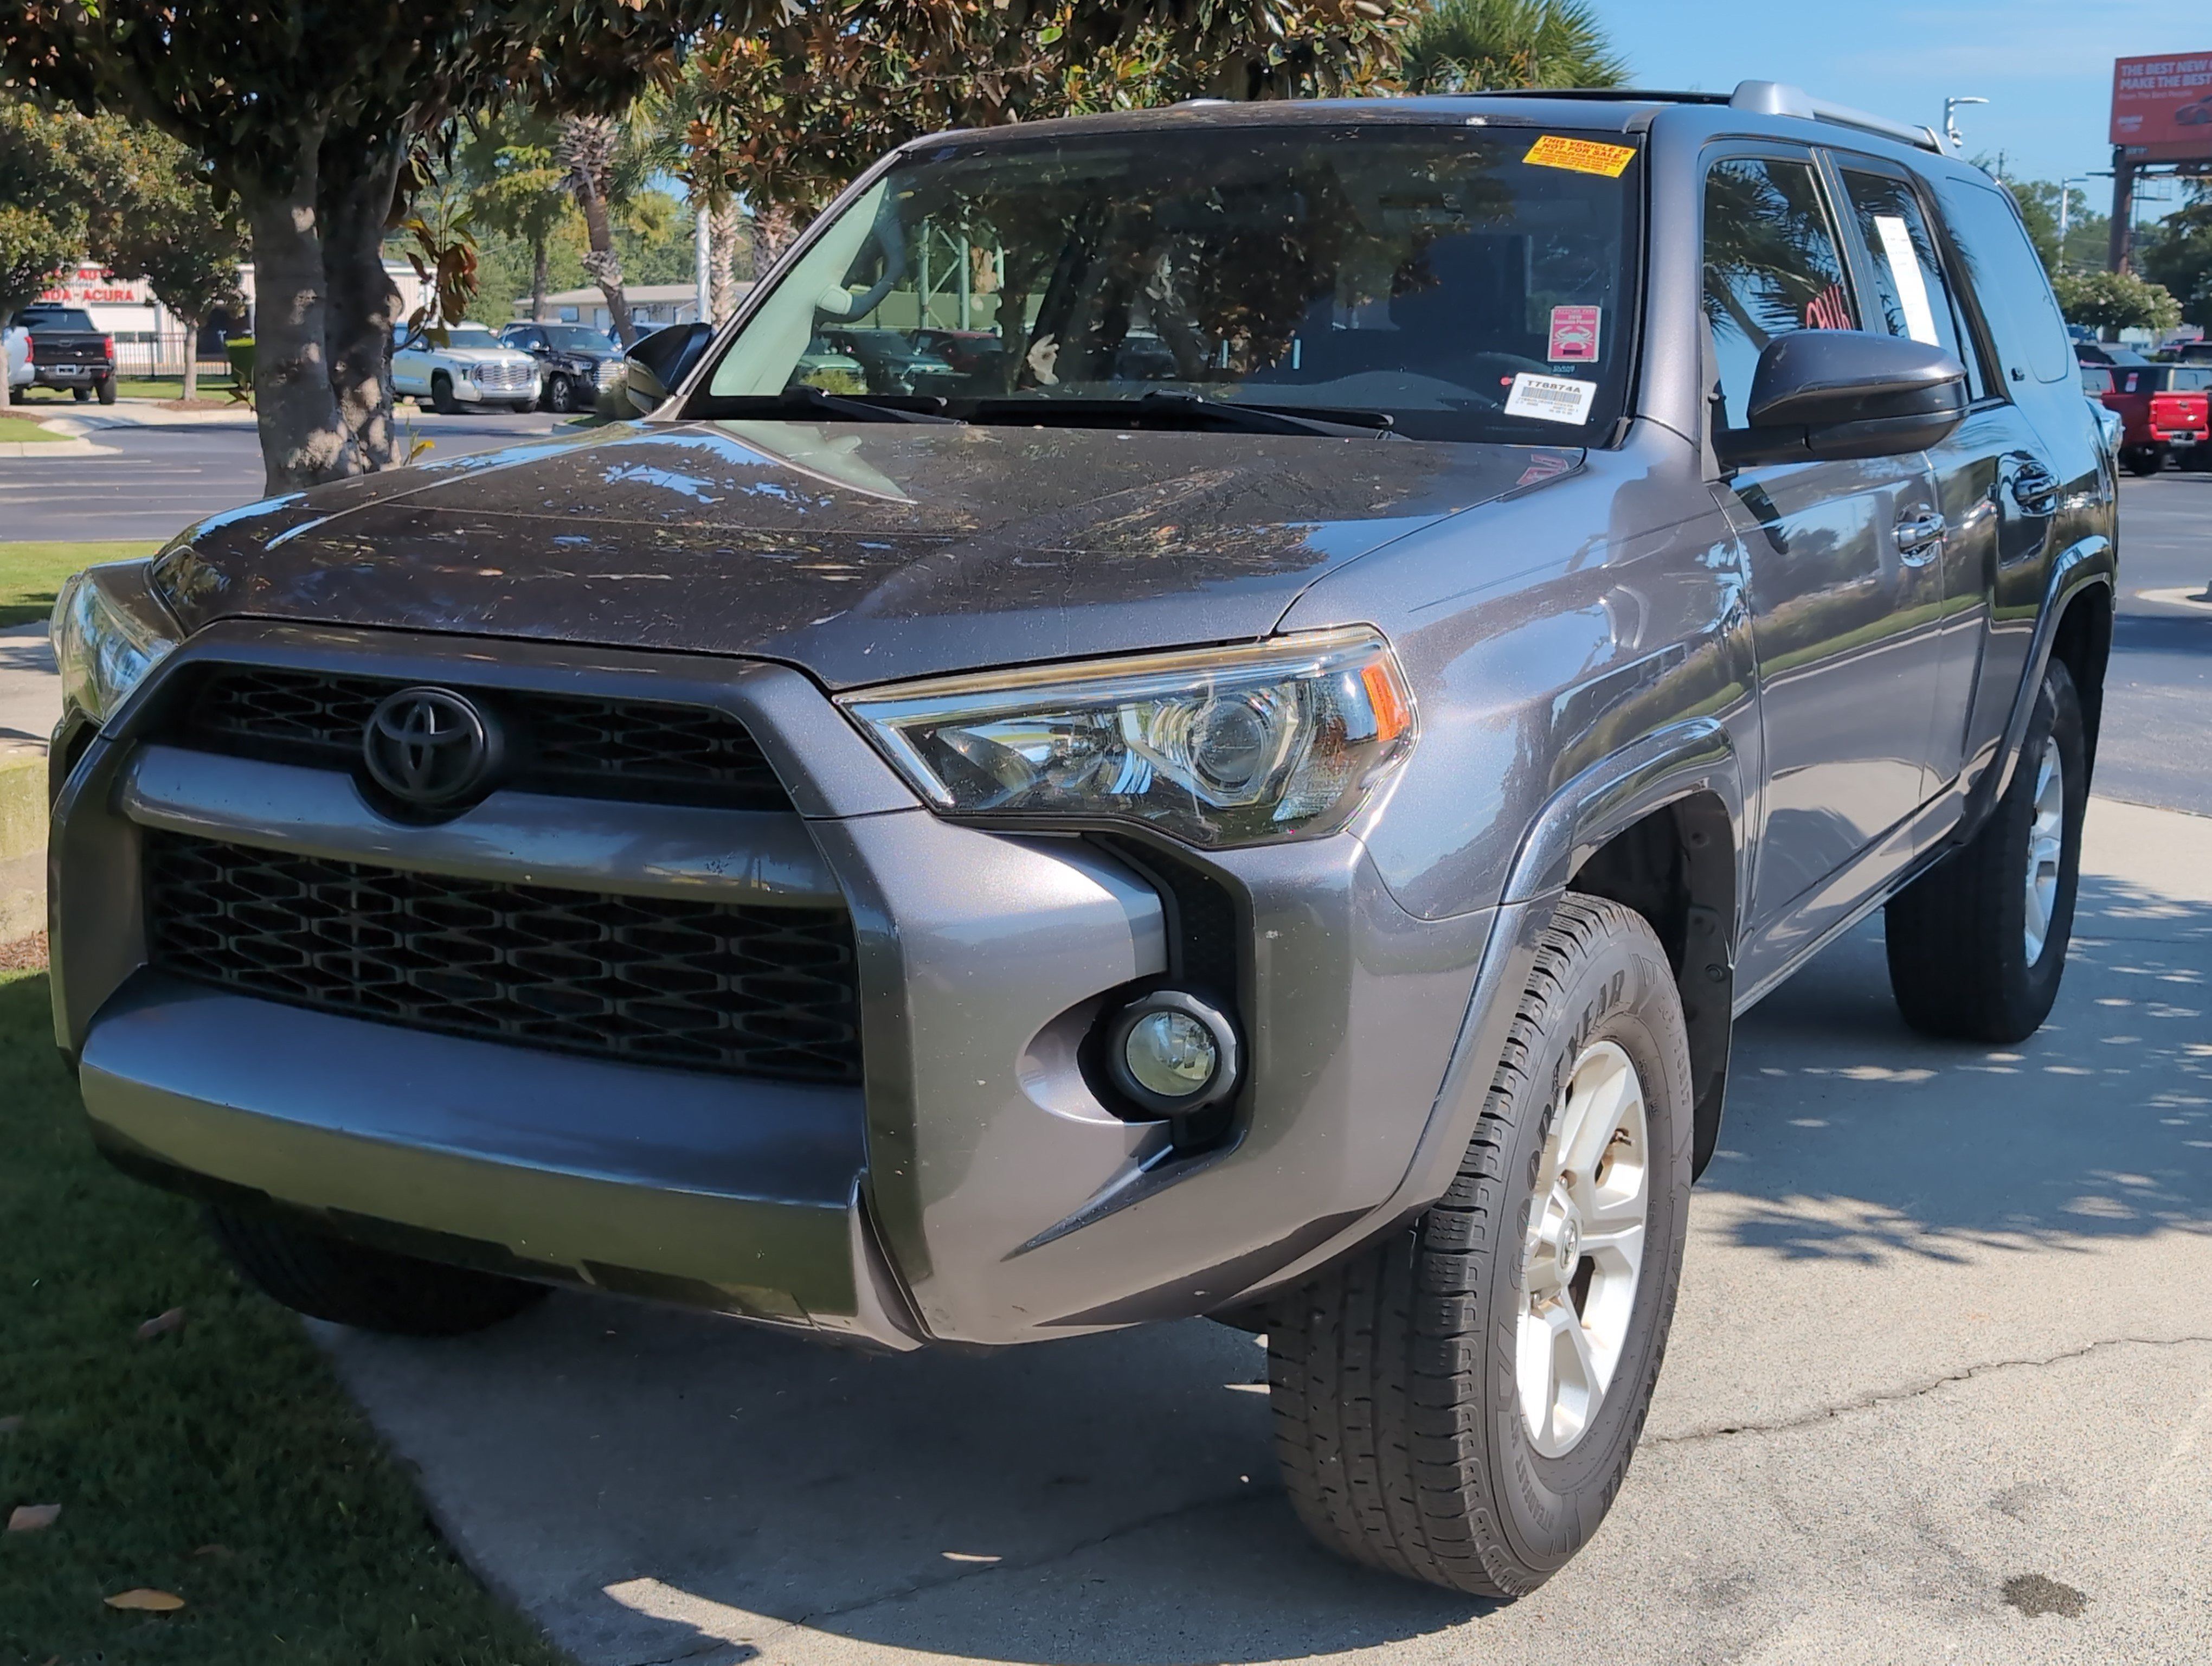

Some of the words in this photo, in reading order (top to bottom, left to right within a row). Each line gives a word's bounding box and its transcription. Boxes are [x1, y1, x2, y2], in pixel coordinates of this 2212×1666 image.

[2121, 64, 2144, 76] THE
[2145, 62, 2176, 75] BEST
[2176, 59, 2209, 73] NEW
[2120, 76, 2156, 90] MAKE
[2157, 75, 2181, 87] THE
[2182, 73, 2212, 86] BEST
[1570, 142, 1617, 151] VEHICLE
[1592, 151, 1622, 159] SALE
[83, 289, 135, 300] ACURA
